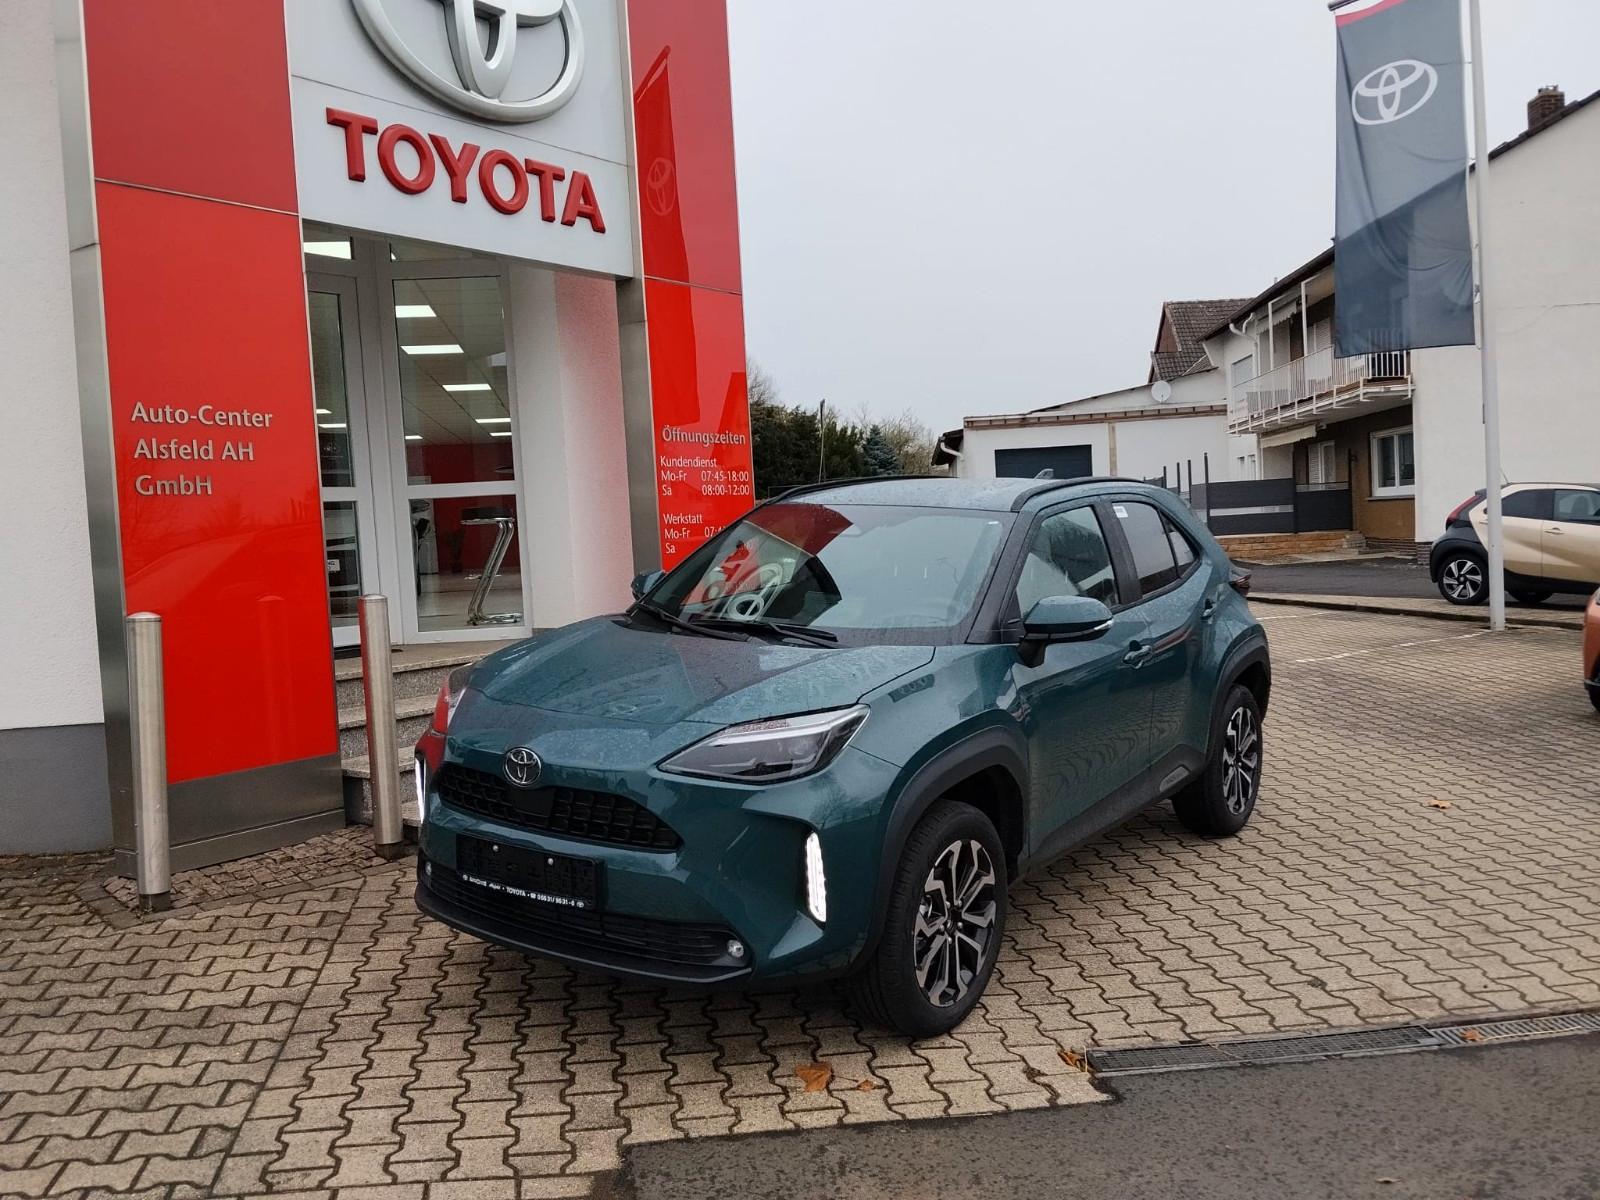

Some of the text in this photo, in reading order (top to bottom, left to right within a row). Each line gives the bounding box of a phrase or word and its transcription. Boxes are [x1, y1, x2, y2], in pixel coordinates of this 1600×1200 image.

[326, 106, 606, 234] TOYOTA
[131, 401, 273, 428] Auto-Center
[662, 424, 746, 447] Öffnungszeiten
[134, 438, 255, 461] Alsfeld AH
[660, 456, 717, 468] Kundendienst
[661, 470, 749, 482] Mo-Fr 07:45-18:00
[135, 474, 213, 496] GmbH
[662, 485, 750, 496] Sa 08:00-12:00
[663, 513, 703, 525] Werkstatt
[664, 528, 691, 539] Mo-Fr
[666, 543, 676, 554] Sa
[506, 886, 526, 897] TOYOTA
